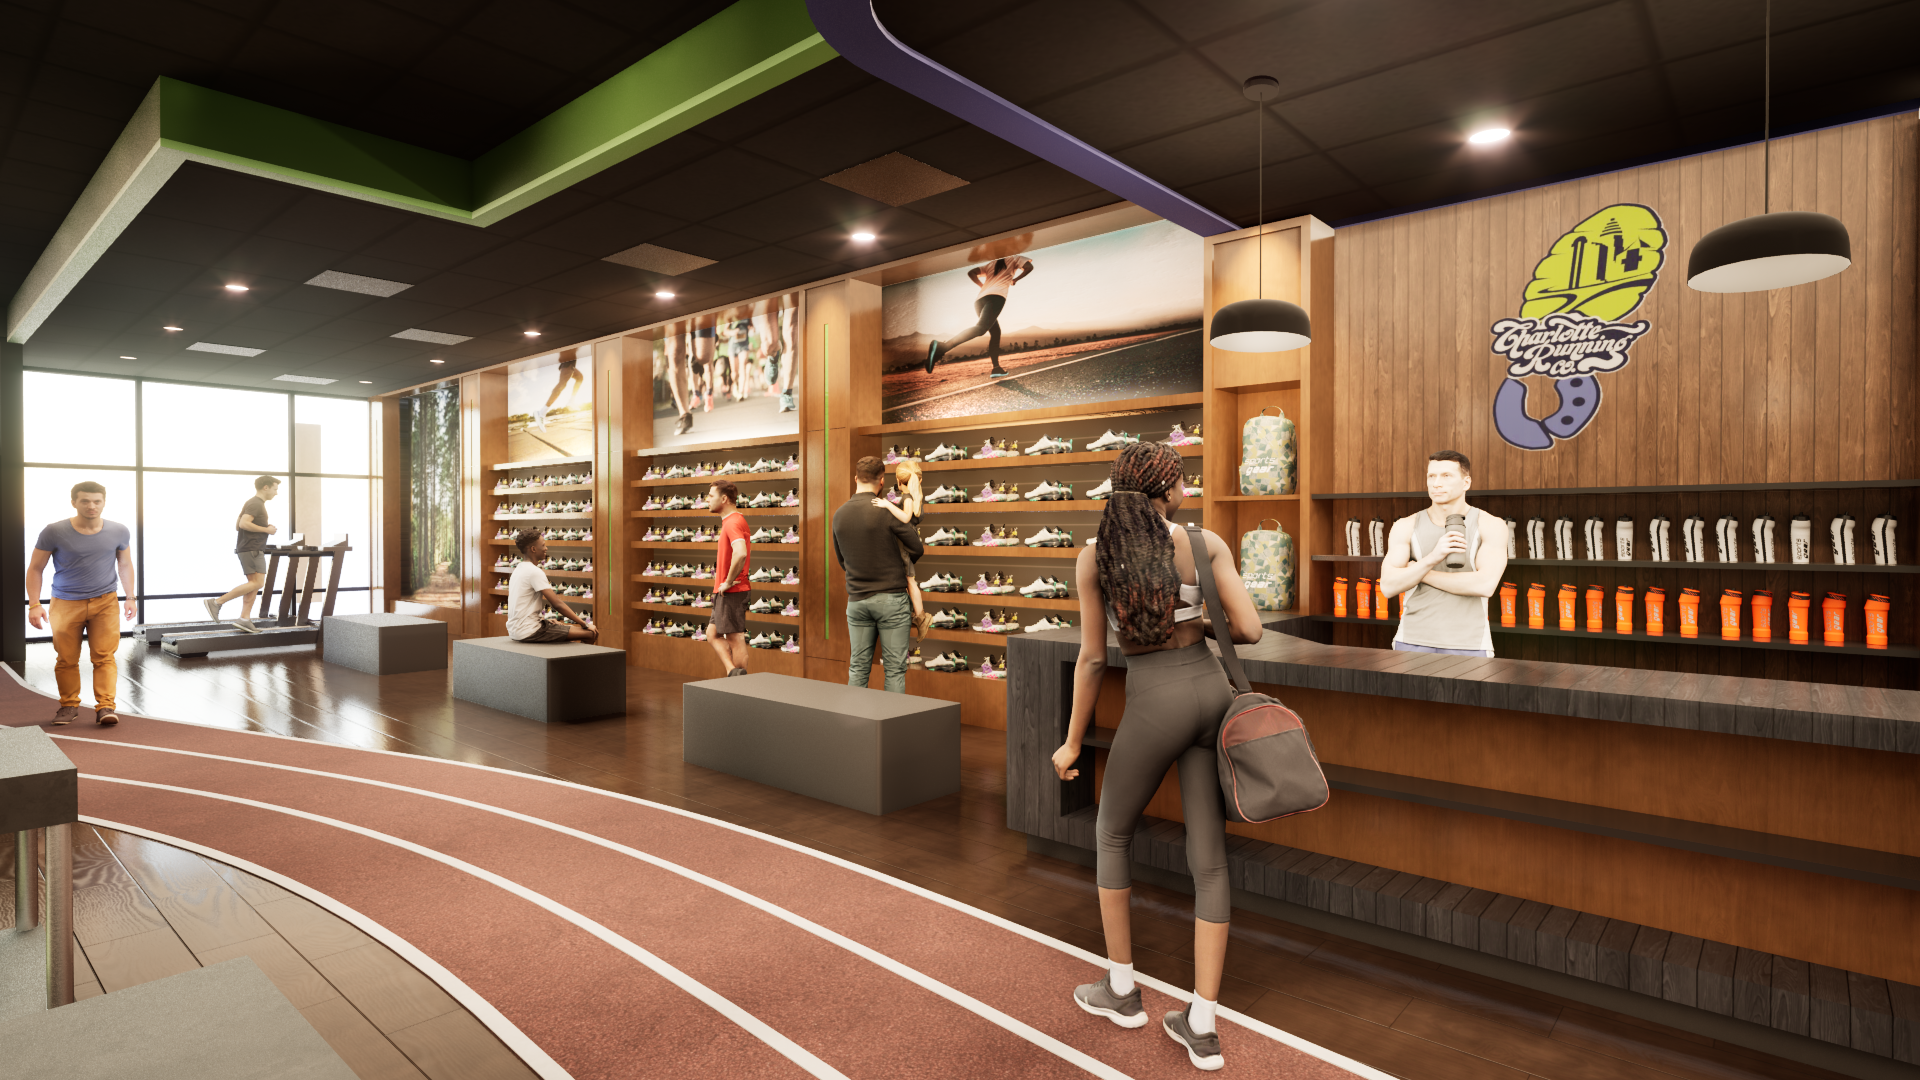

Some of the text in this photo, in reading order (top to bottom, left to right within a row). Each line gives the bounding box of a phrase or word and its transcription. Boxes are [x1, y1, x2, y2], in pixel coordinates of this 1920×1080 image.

[1493, 315, 1645, 358] Charlotte
[1510, 334, 1633, 375] Running
[1244, 456, 1276, 465] sports
[1245, 465, 1275, 476] gear
[1791, 610, 1800, 630] gear
[1876, 614, 1885, 634] gear
